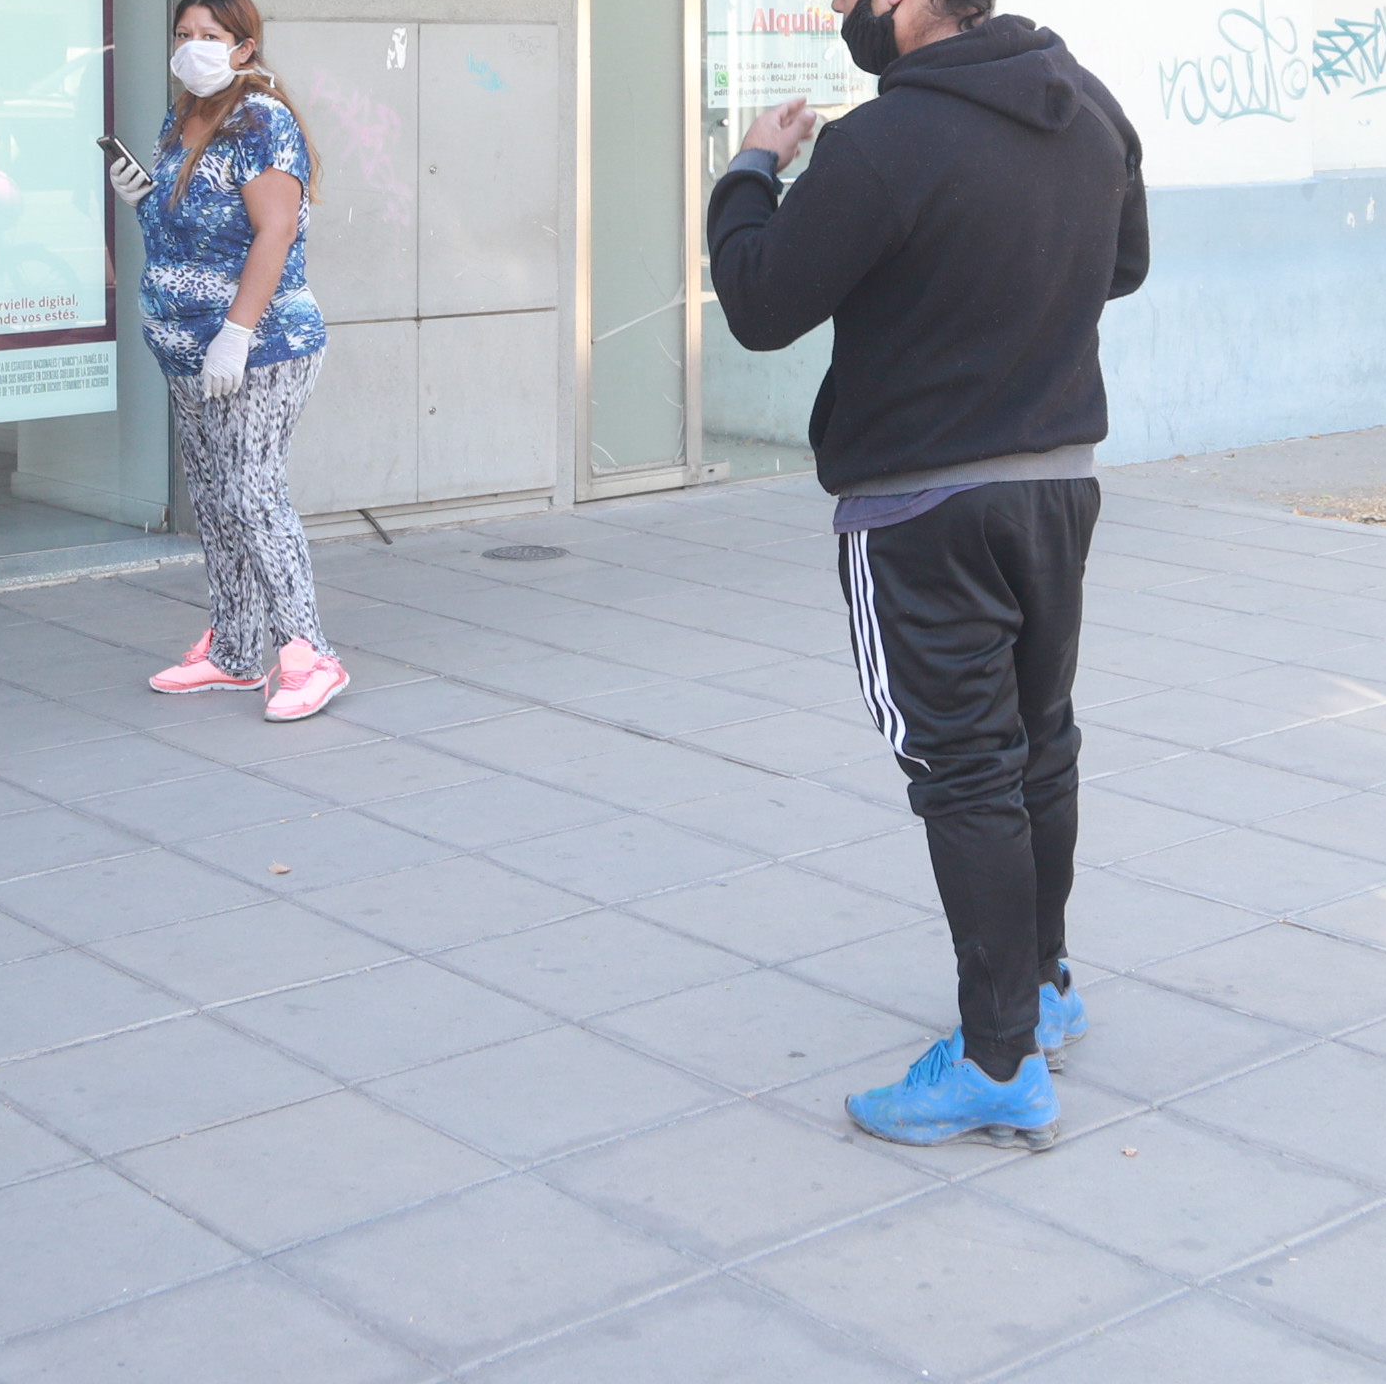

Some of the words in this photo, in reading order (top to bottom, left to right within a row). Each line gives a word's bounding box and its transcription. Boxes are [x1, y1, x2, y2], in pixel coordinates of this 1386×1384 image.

[751, 7, 835, 37] Alquila
[38, 294, 79, 308] digital,
[21, 313, 41, 323] vos
[44, 309, 79, 322] estés.
